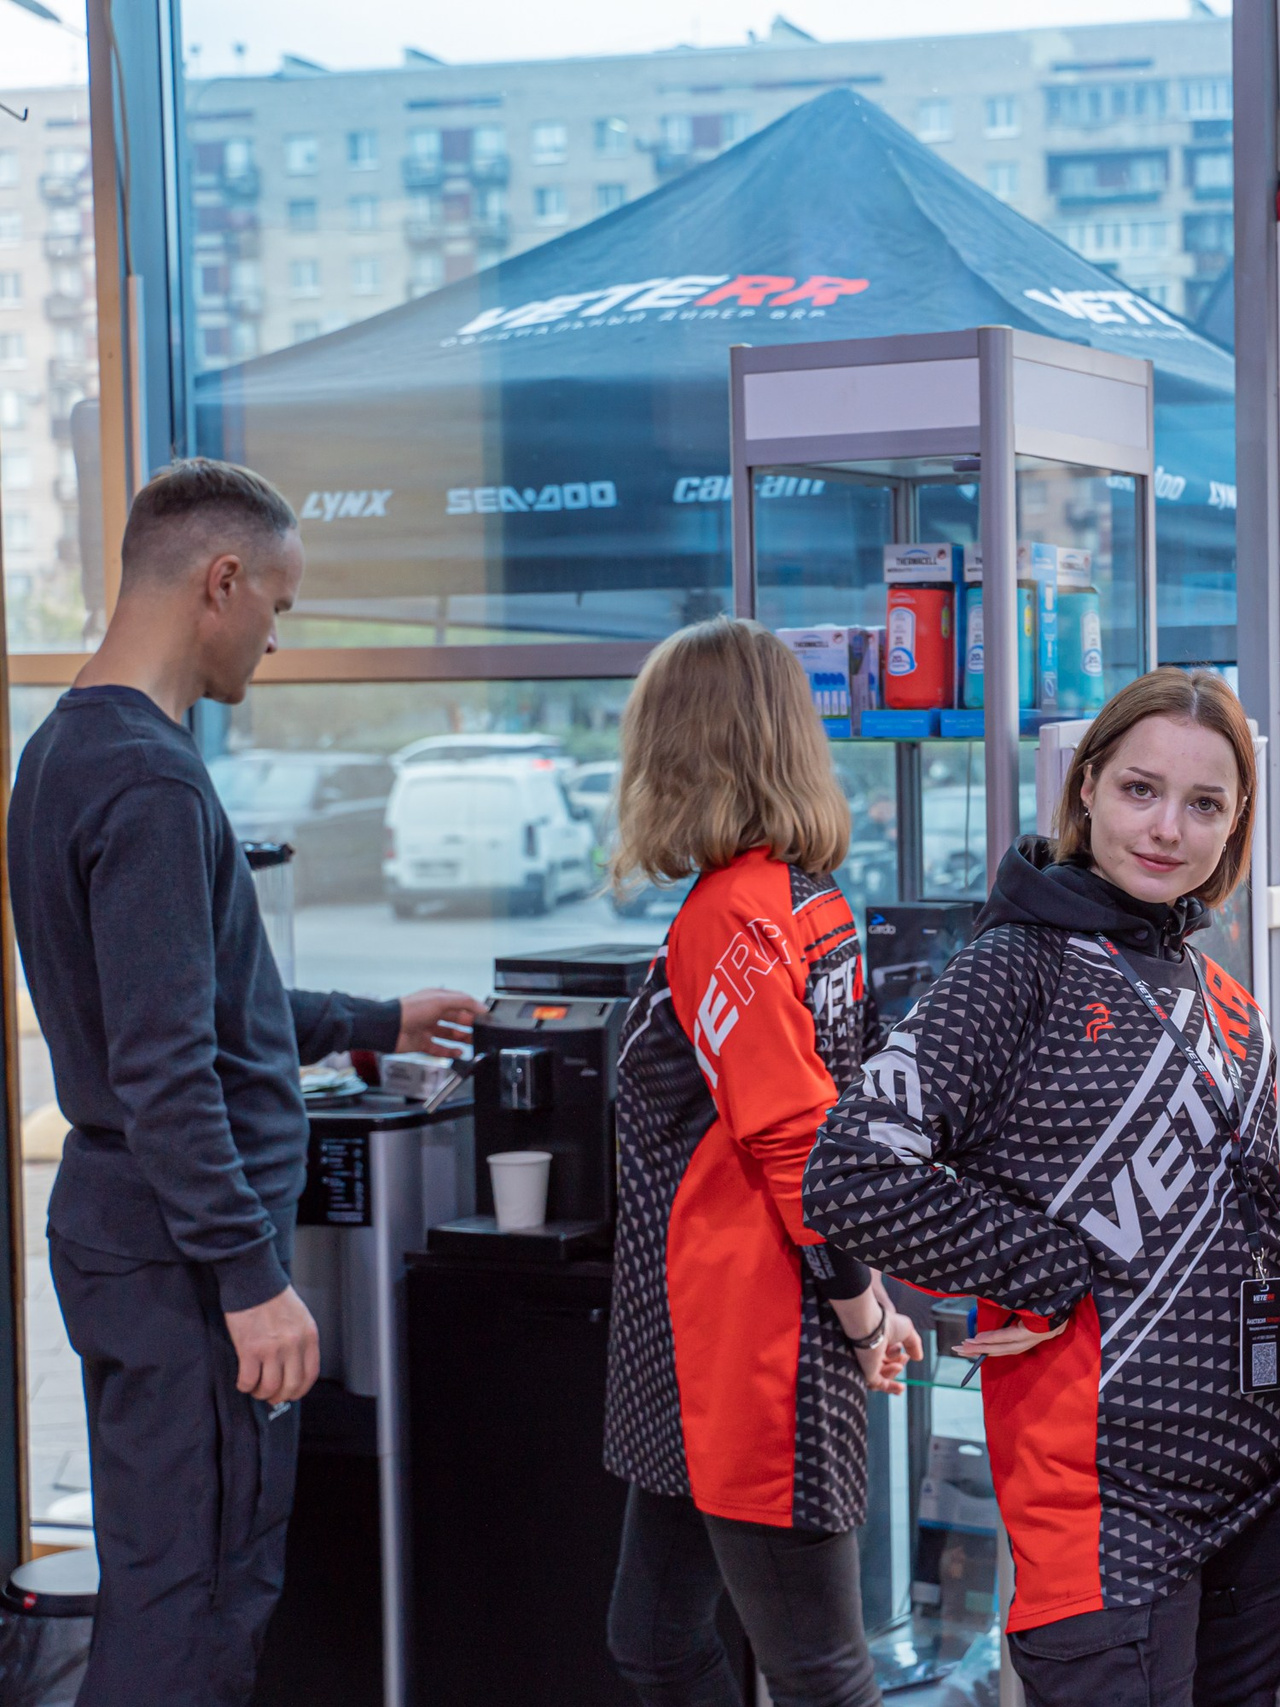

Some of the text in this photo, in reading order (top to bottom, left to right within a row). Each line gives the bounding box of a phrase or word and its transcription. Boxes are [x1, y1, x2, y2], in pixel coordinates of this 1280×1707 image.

[457, 274, 870, 335] VETERR
[301, 489, 393, 522] LYNX
[1134, 980, 1168, 1021] VETERR
[1184, 1045, 1216, 1087] VETERR
